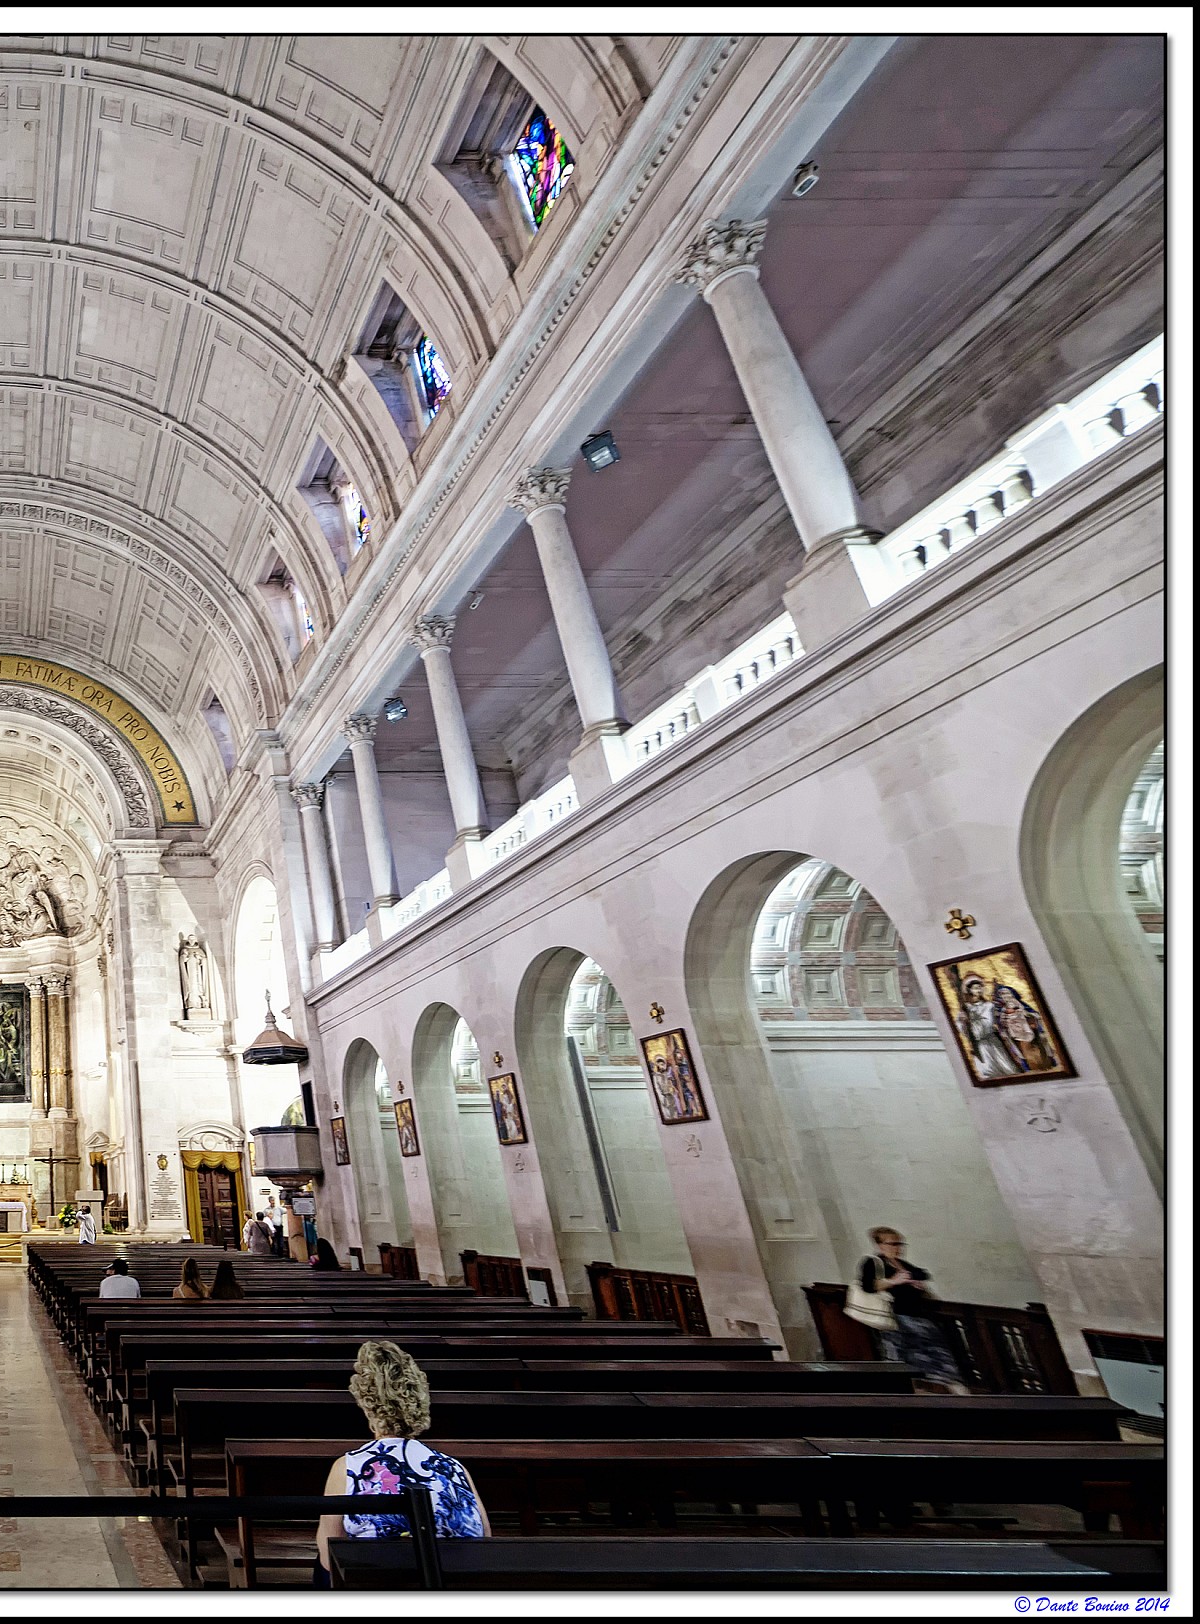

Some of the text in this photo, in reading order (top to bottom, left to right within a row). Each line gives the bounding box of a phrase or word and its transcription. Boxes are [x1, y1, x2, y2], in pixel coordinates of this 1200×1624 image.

[81, 685, 114, 713] ORA
[117, 711, 149, 741] PRO
[145, 745, 181, 794] NOBIS
